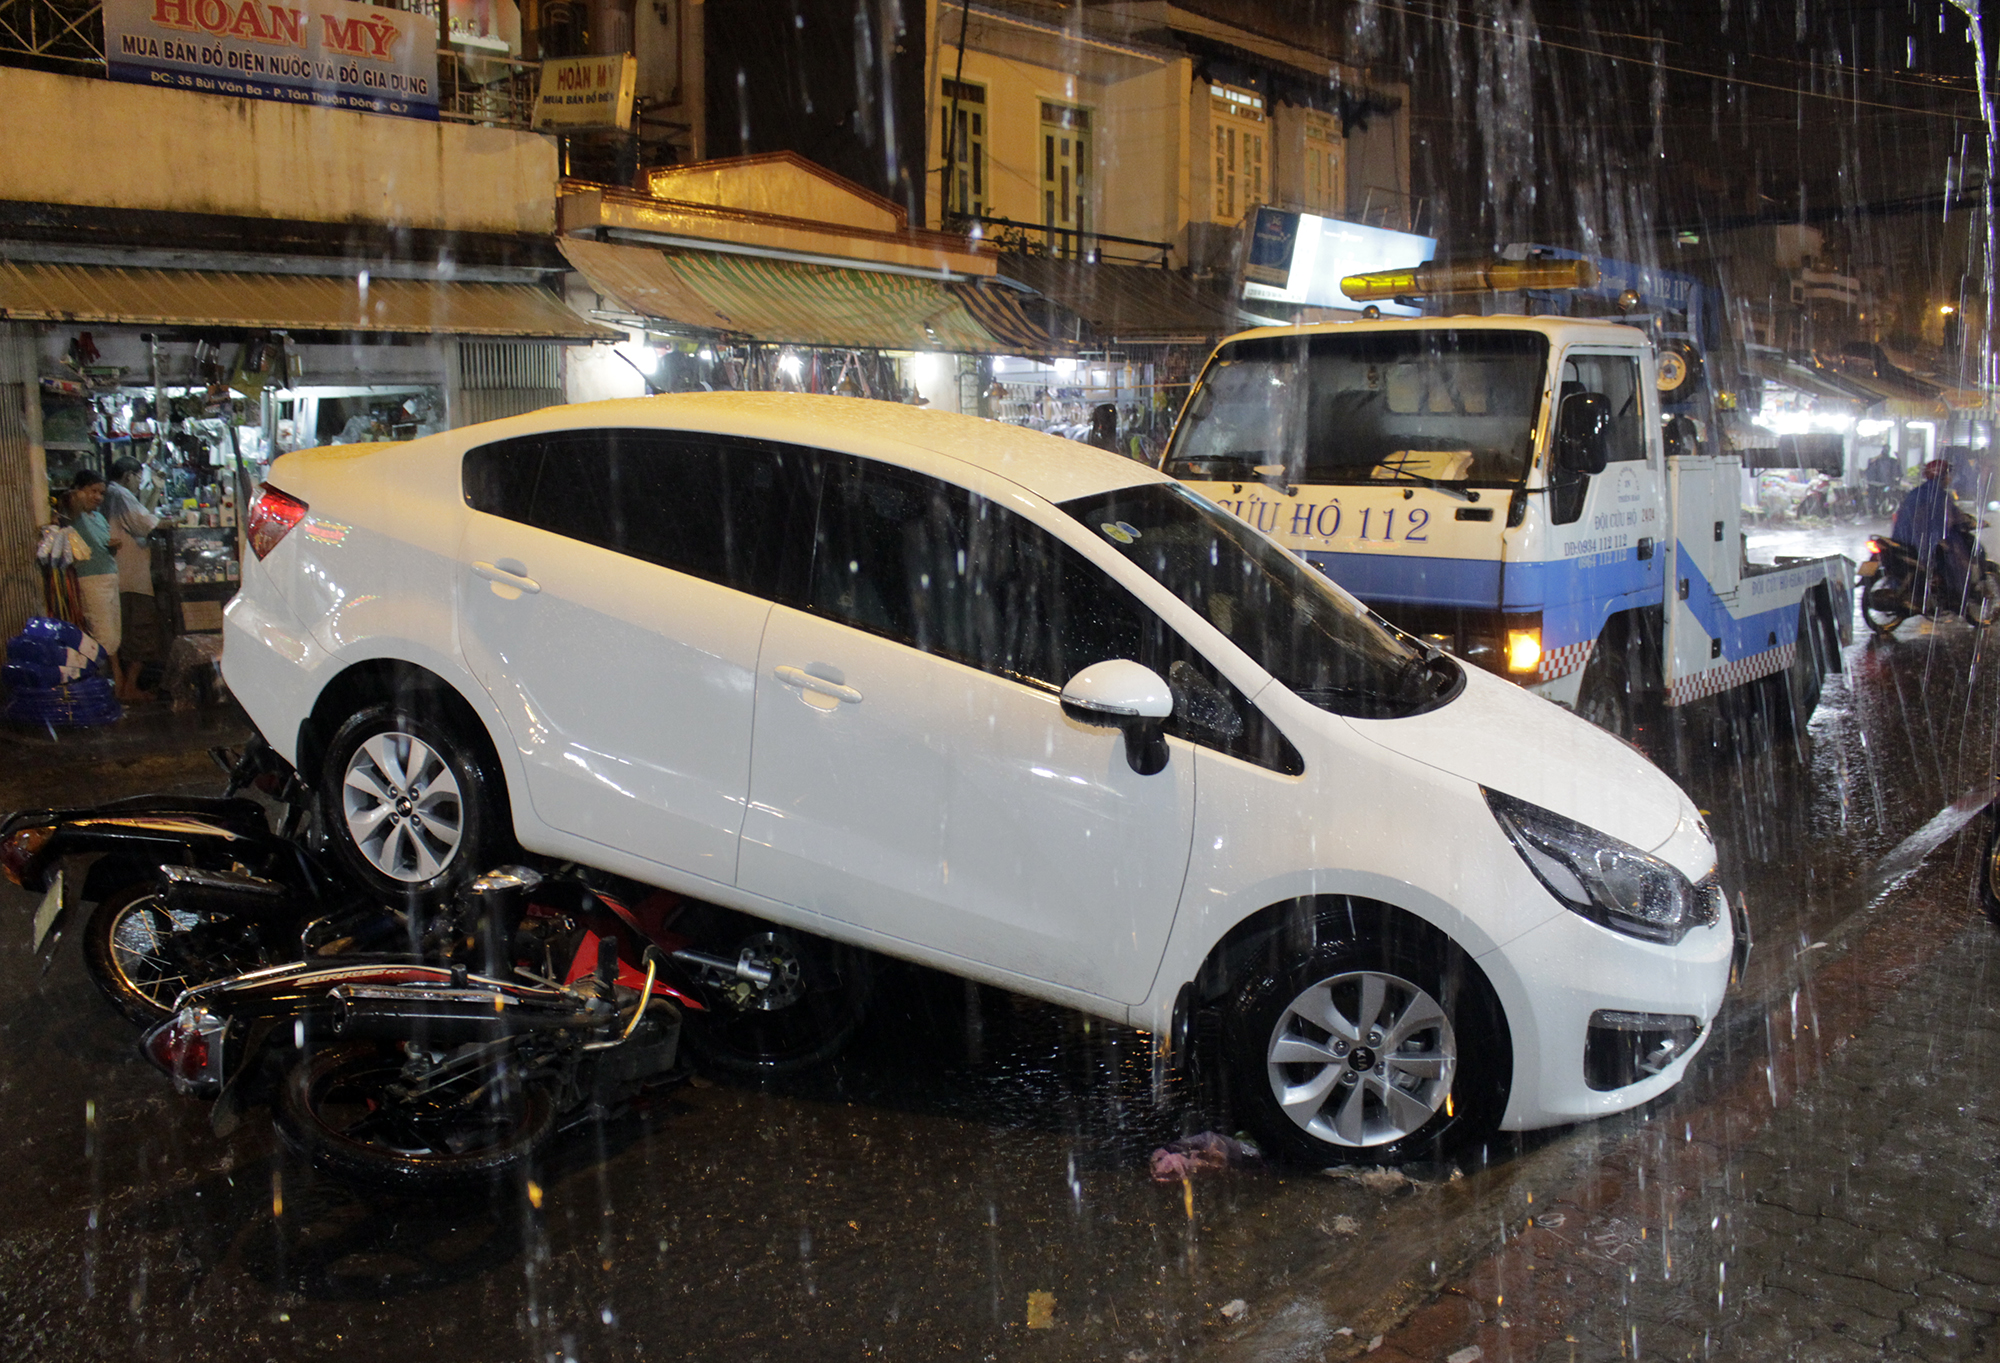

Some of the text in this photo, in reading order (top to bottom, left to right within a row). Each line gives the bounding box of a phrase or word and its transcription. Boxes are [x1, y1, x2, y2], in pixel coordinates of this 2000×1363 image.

[122, 34, 428, 98] MUA BÁN ĐỒ ĐIỆN NƯỚC VÀ ĐỒ GIA DỤNG
[557, 61, 591, 91] HOÀN
[177, 75, 193, 87] 35
[246, 84, 263, 96] Ba
[273, 88, 284, 99] P.
[1290, 498, 1343, 545] HỘ
[1358, 507, 1430, 543] 112
[1599, 535, 1613, 551] 112
[1614, 533, 1628, 549] 112
